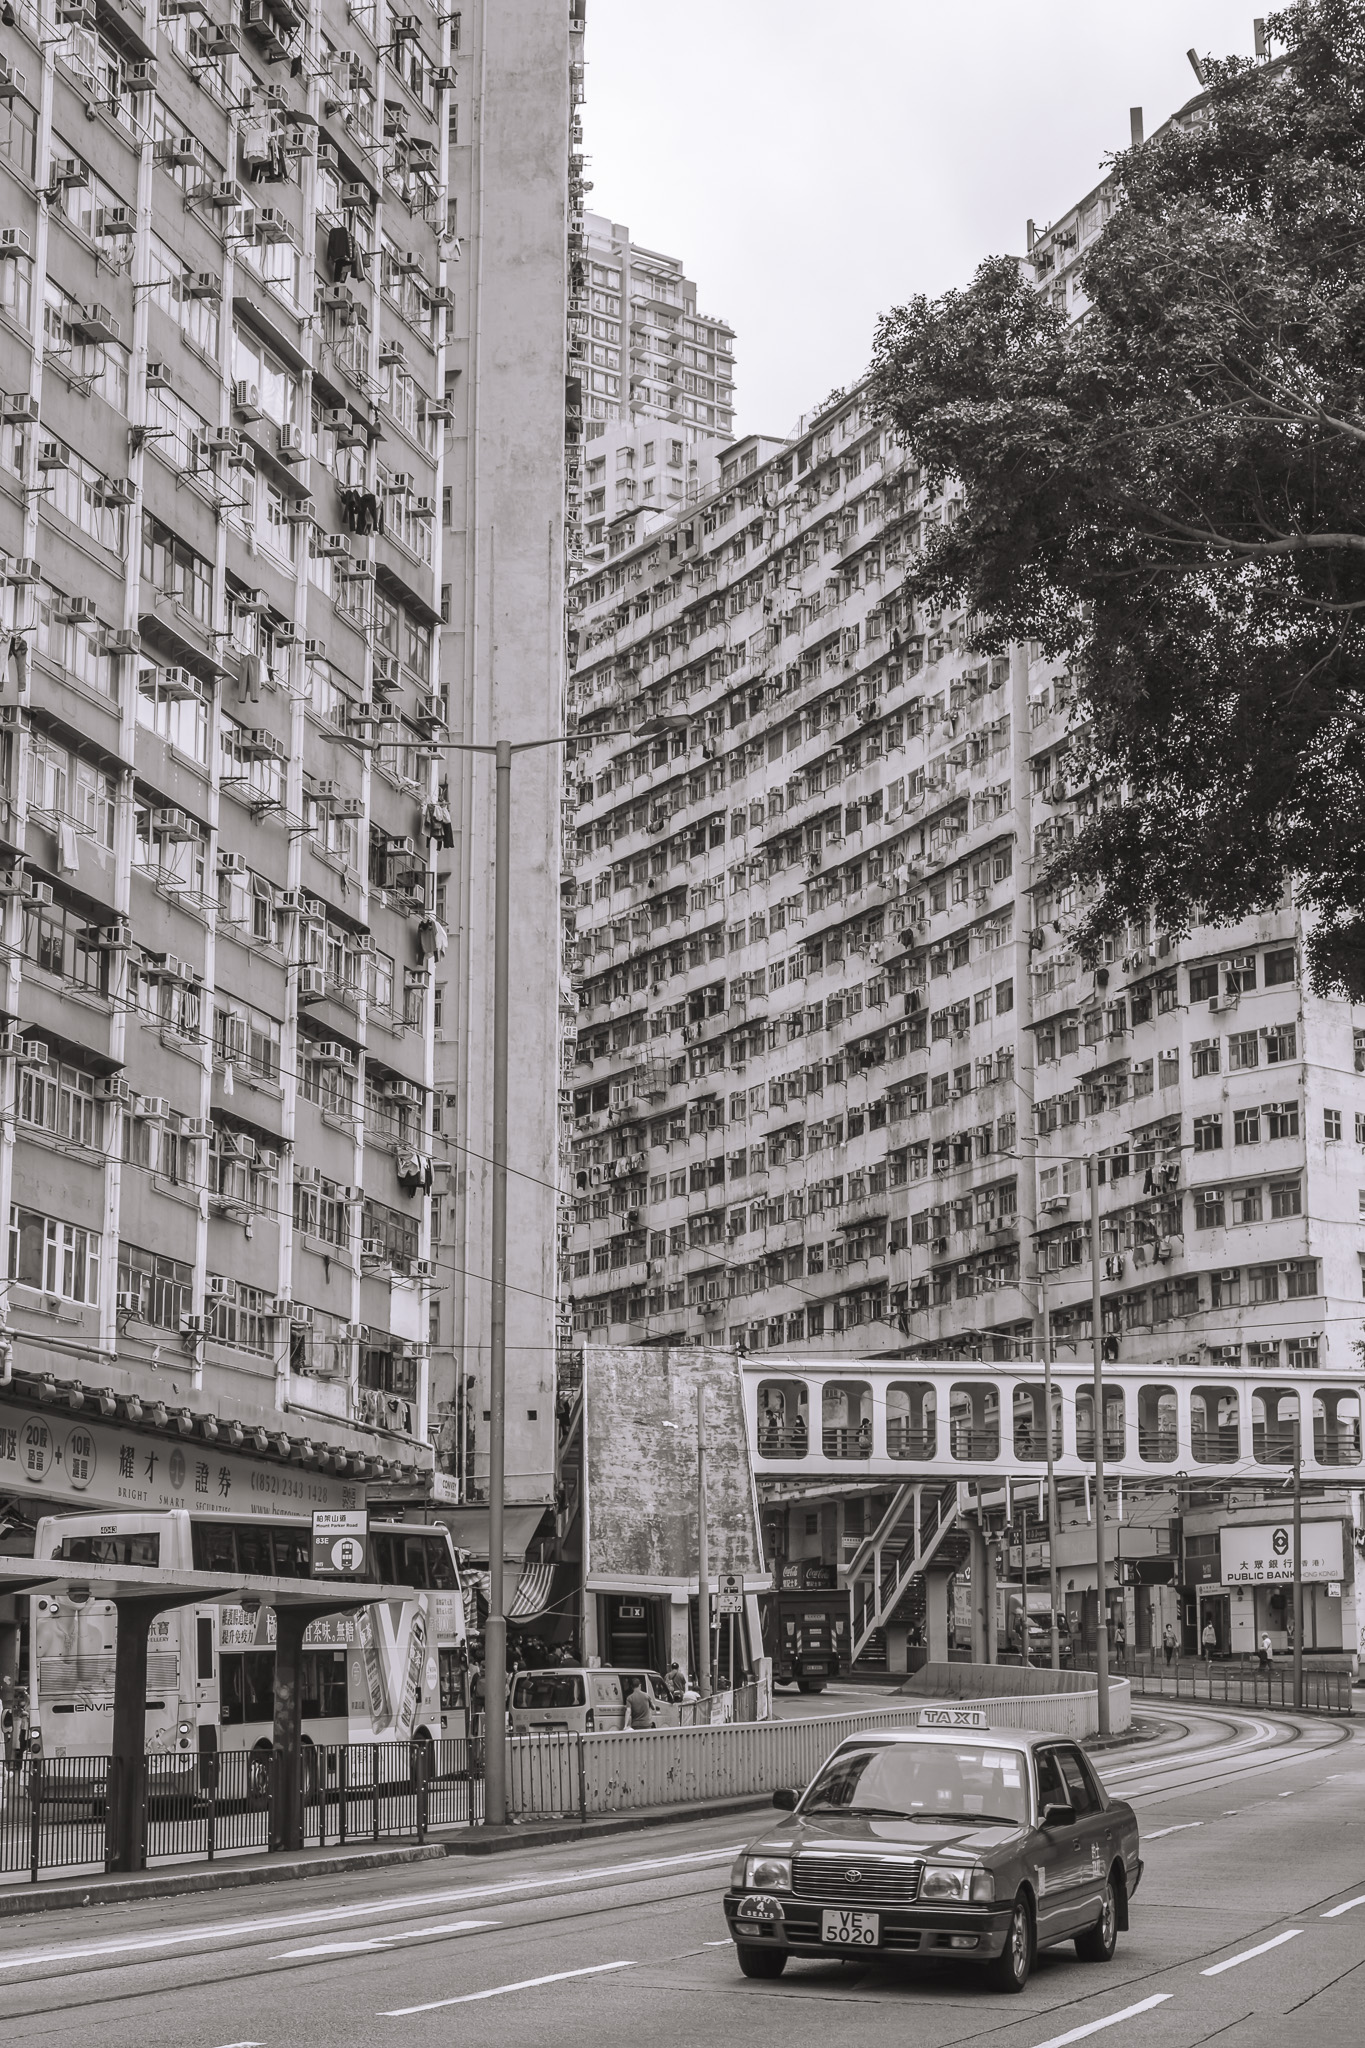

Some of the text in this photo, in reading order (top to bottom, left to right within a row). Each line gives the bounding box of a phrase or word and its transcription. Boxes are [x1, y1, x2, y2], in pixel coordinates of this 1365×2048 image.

[118, 1444, 231, 1498] 耀才 證券
[256, 1471, 328, 1504] (852) 2343 1428
[118, 1486, 148, 1502] BRIGHT
[159, 1494, 185, 1509] SMART
[316, 1514, 347, 1523] 柏架山道
[315, 1537, 330, 1545] 83E
[1227, 1572, 1264, 1582] PUBLIC
[924, 1710, 980, 1725] TAXI
[752, 1895, 772, 1904] TAXI
[756, 1902, 765, 1912] 4
[746, 1910, 775, 1919] SEATS
[839, 1911, 863, 1928] VE
[826, 1925, 875, 1944] 5020
